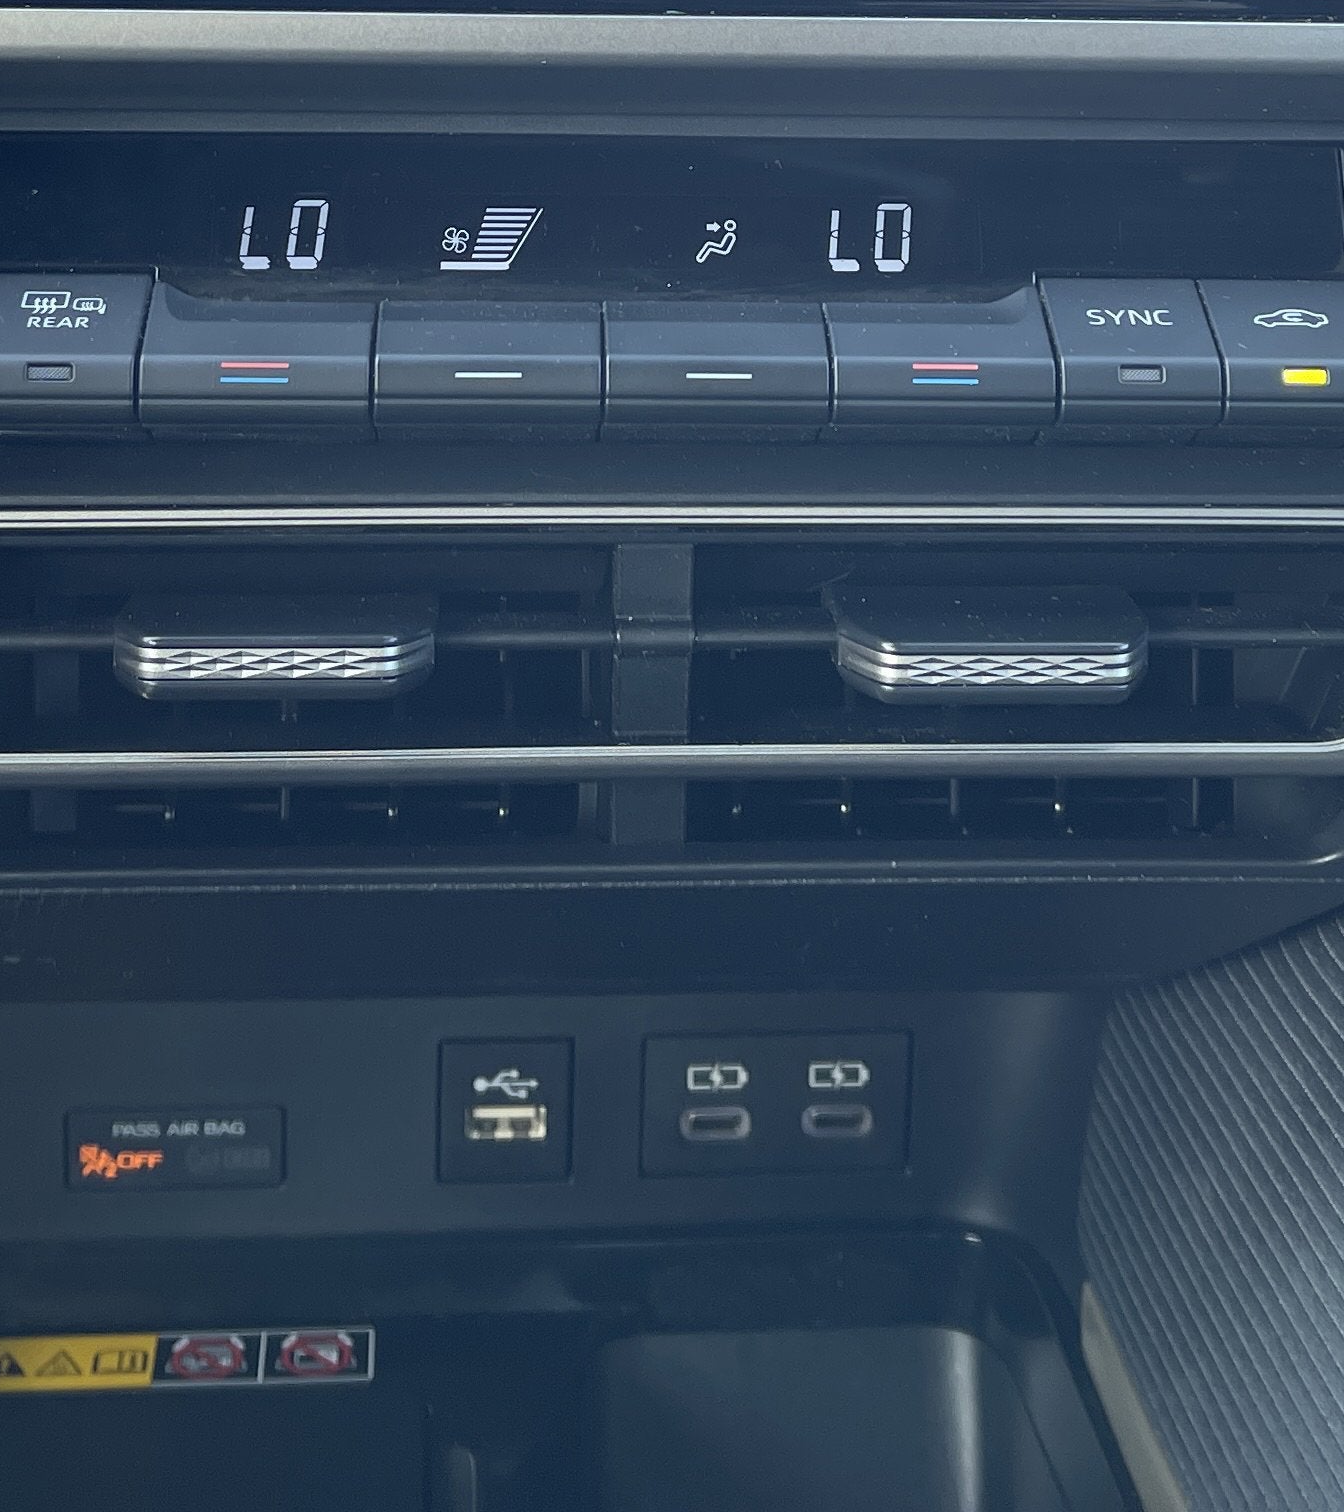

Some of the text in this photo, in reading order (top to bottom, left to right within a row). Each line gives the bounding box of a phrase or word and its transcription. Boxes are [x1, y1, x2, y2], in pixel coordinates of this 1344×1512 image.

[27, 315, 89, 329] REAR
[1087, 308, 1174, 327] SYNC
[111, 1119, 246, 1137] PASS AIR BAG
[116, 1151, 164, 1169] OFF
